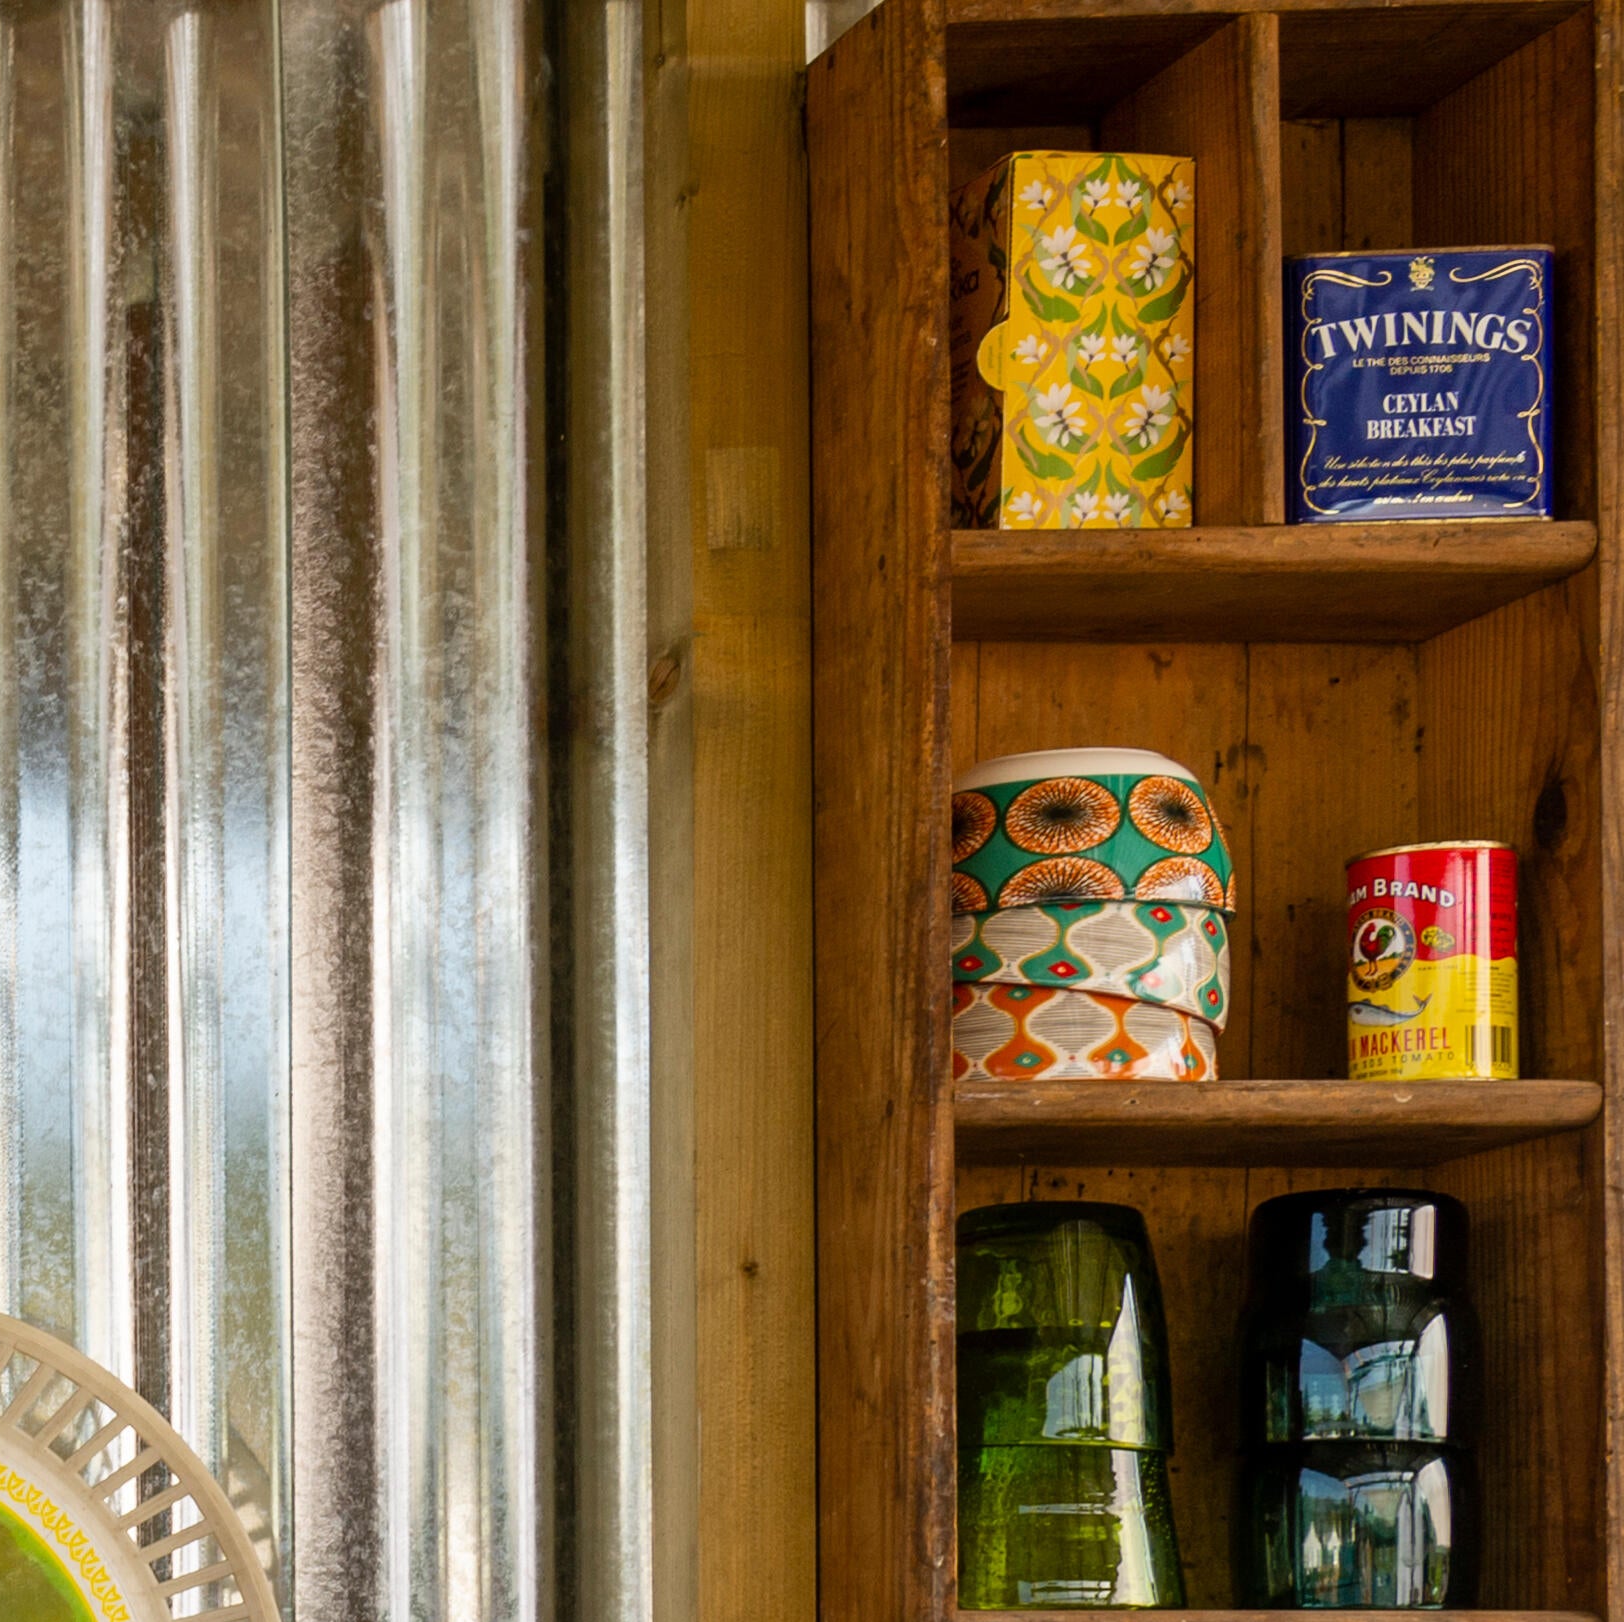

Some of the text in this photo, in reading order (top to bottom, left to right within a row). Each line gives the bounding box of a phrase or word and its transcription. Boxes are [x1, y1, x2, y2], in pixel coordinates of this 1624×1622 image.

[1311, 310, 1532, 360] TWININGS
[1383, 391, 1460, 414] CEYLAN
[1366, 416, 1477, 440] BREAKFAST
[1373, 878, 1455, 908] BRAND
[1360, 1027, 1451, 1059] MACKEREL
[1392, 1052, 1455, 1064] TOMATO
